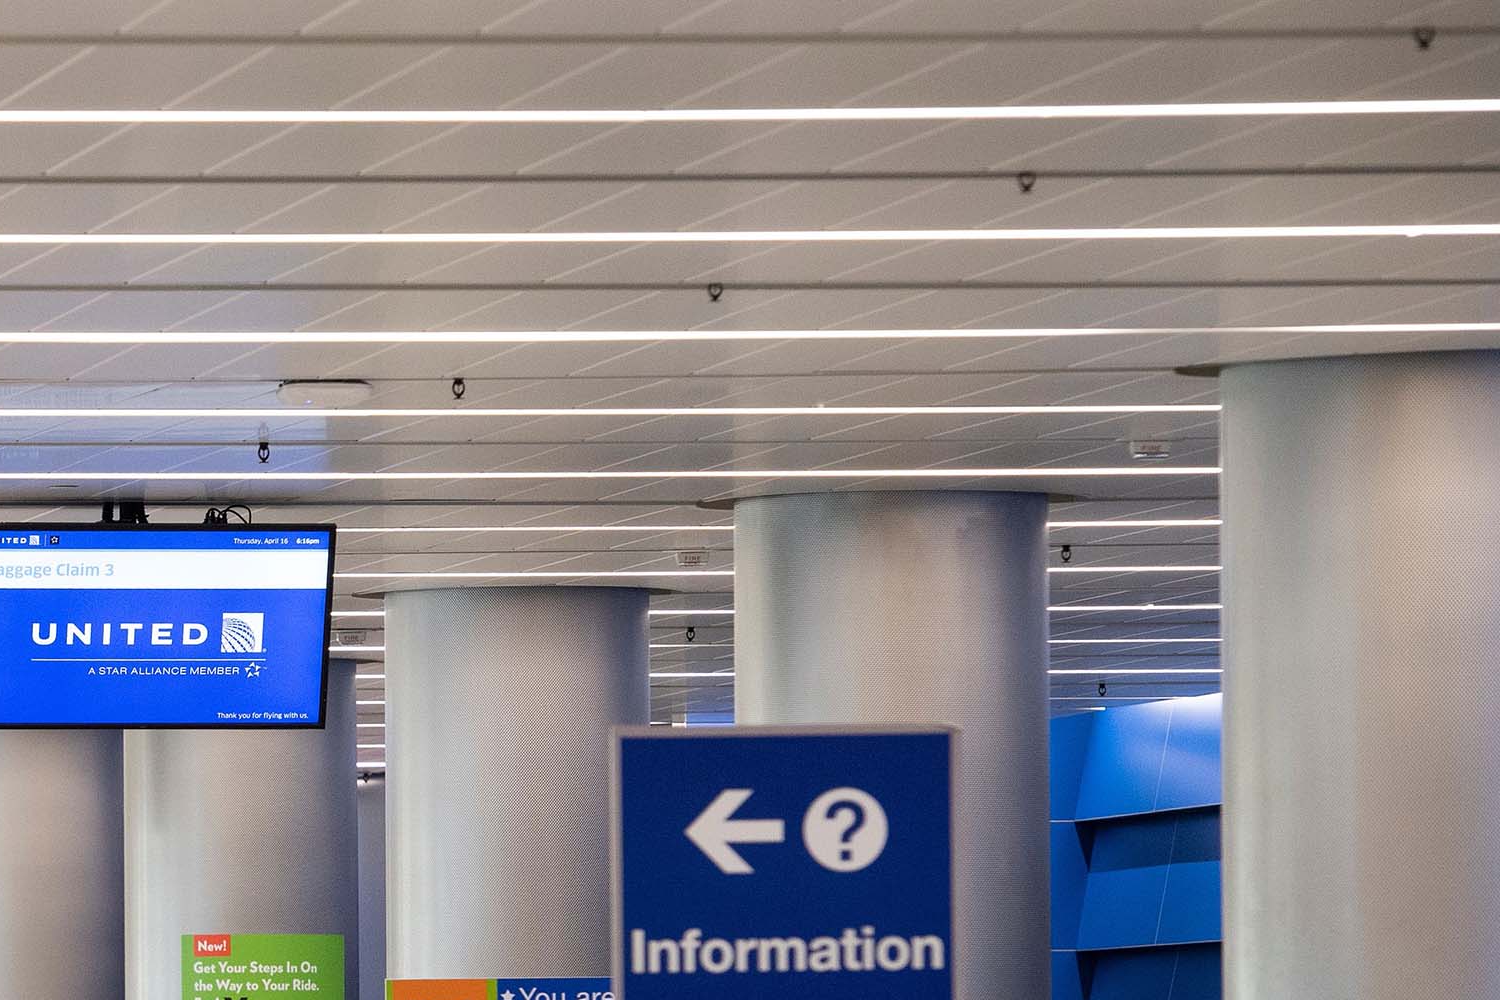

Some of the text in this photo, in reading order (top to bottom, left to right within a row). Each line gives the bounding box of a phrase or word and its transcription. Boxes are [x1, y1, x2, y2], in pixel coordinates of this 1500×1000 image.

[264, 537, 279, 545] April
[57, 562, 100, 577] Claim
[105, 563, 115, 577] 3
[31, 622, 209, 647] UNITED
[87, 666, 240, 675] A STAR ALLIANCE MEMBER
[263, 712, 282, 720] flying
[197, 940, 228, 952] New!
[631, 926, 945, 974] Information
[194, 961, 318, 976] Get Your Steps In On
[194, 978, 320, 994] the Way to Your Ride.
